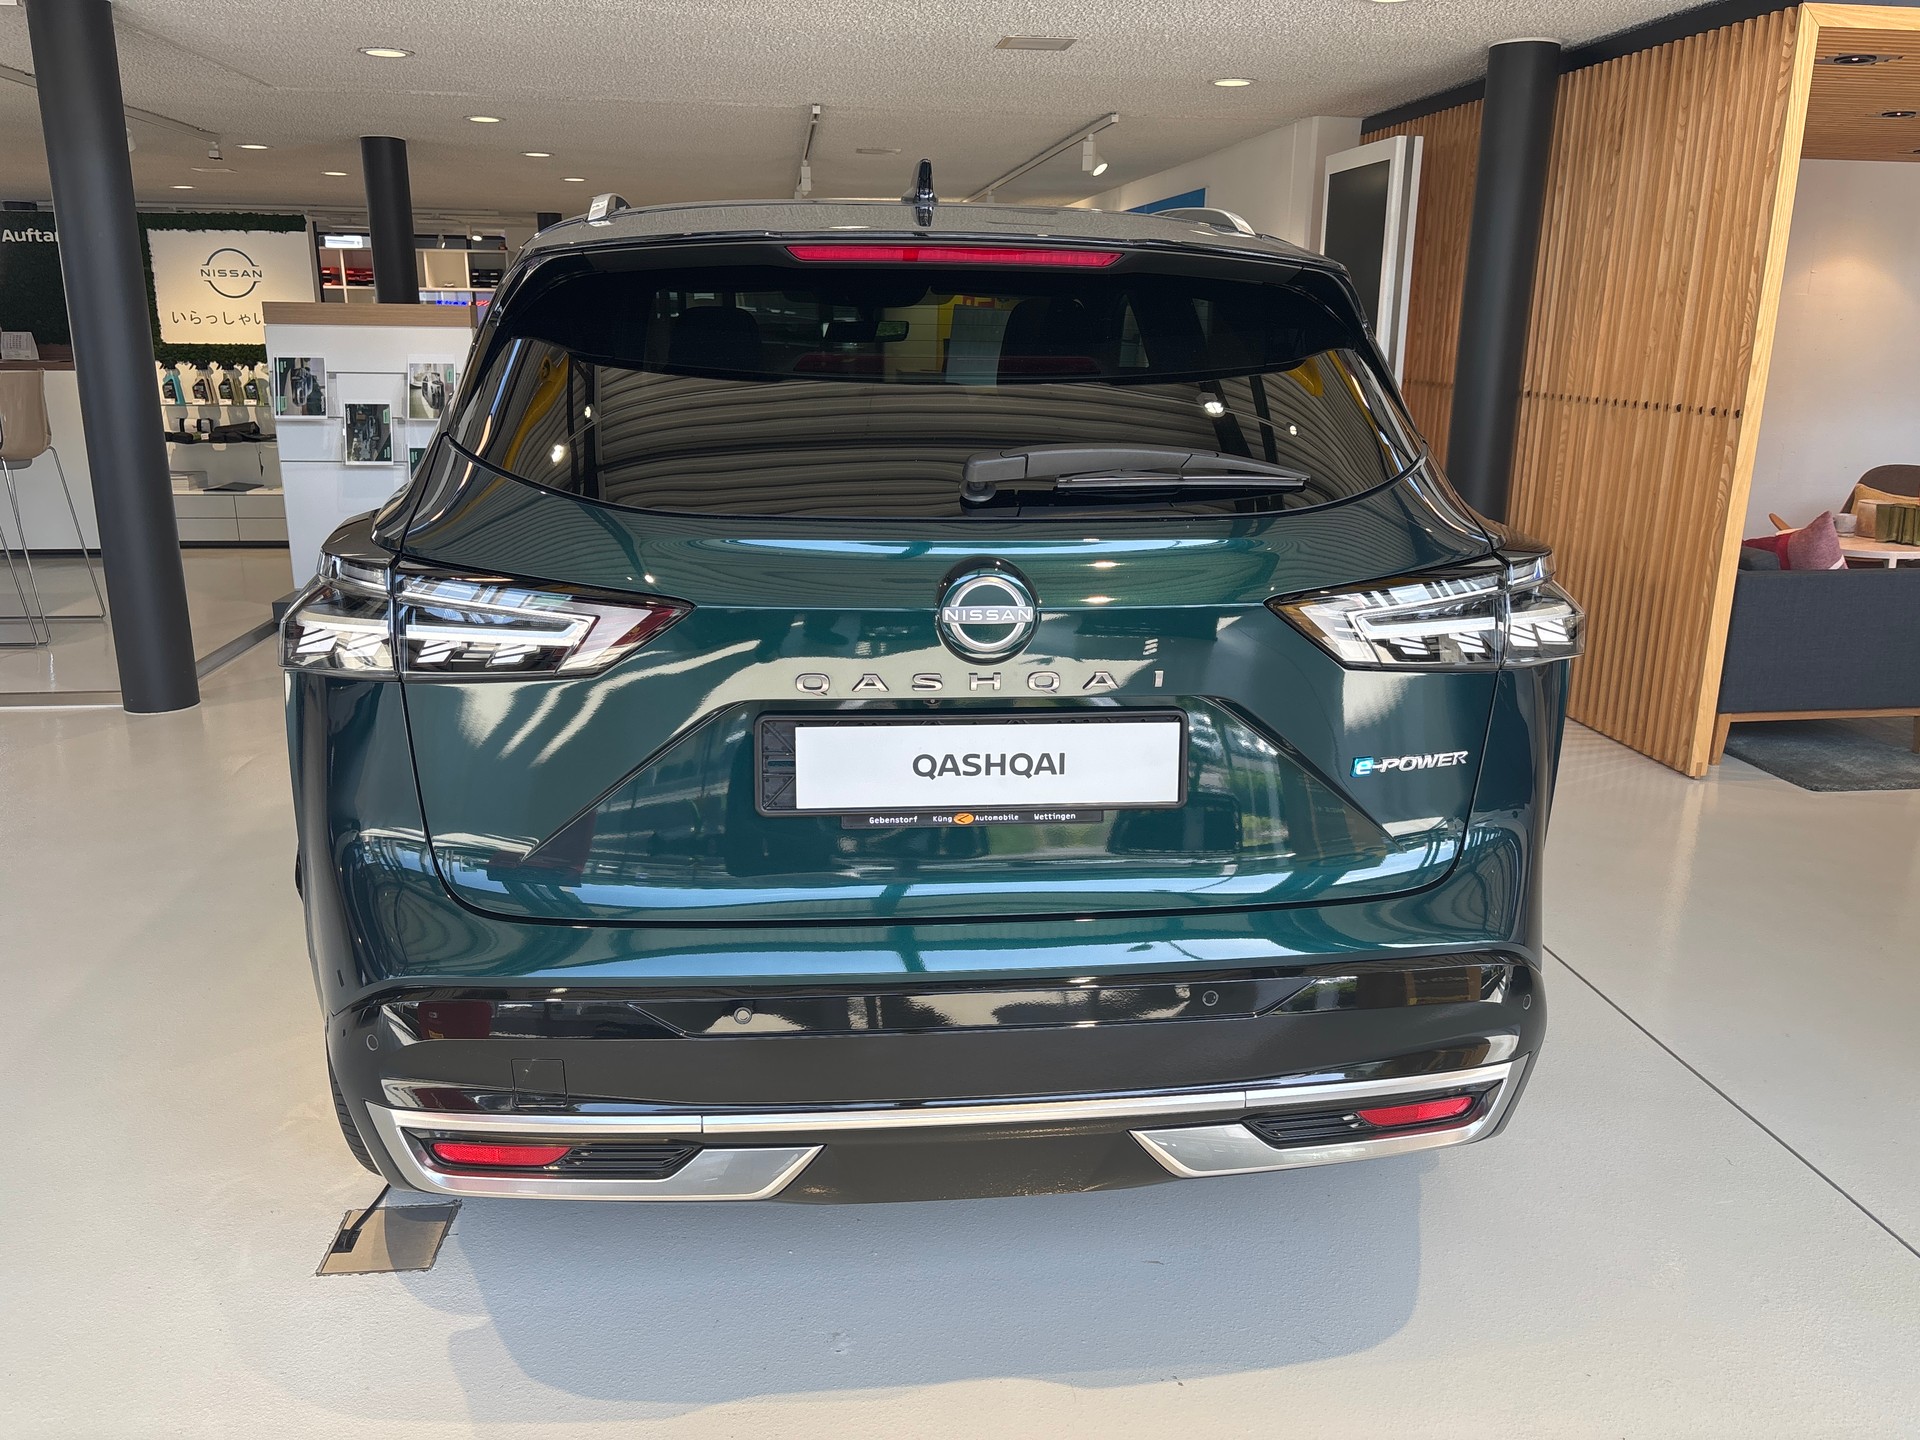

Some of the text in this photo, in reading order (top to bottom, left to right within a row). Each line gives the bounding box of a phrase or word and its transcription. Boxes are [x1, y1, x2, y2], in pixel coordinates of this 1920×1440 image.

[200, 269, 262, 278] NISSAN
[944, 608, 1032, 621] NISSAN
[795, 670, 1164, 696] QASHQAI
[912, 752, 1066, 780] QASHQAI
[1352, 750, 1469, 776] e-POWER
[869, 812, 1076, 824] Gebenstorf Küng Automobile Wettingen
